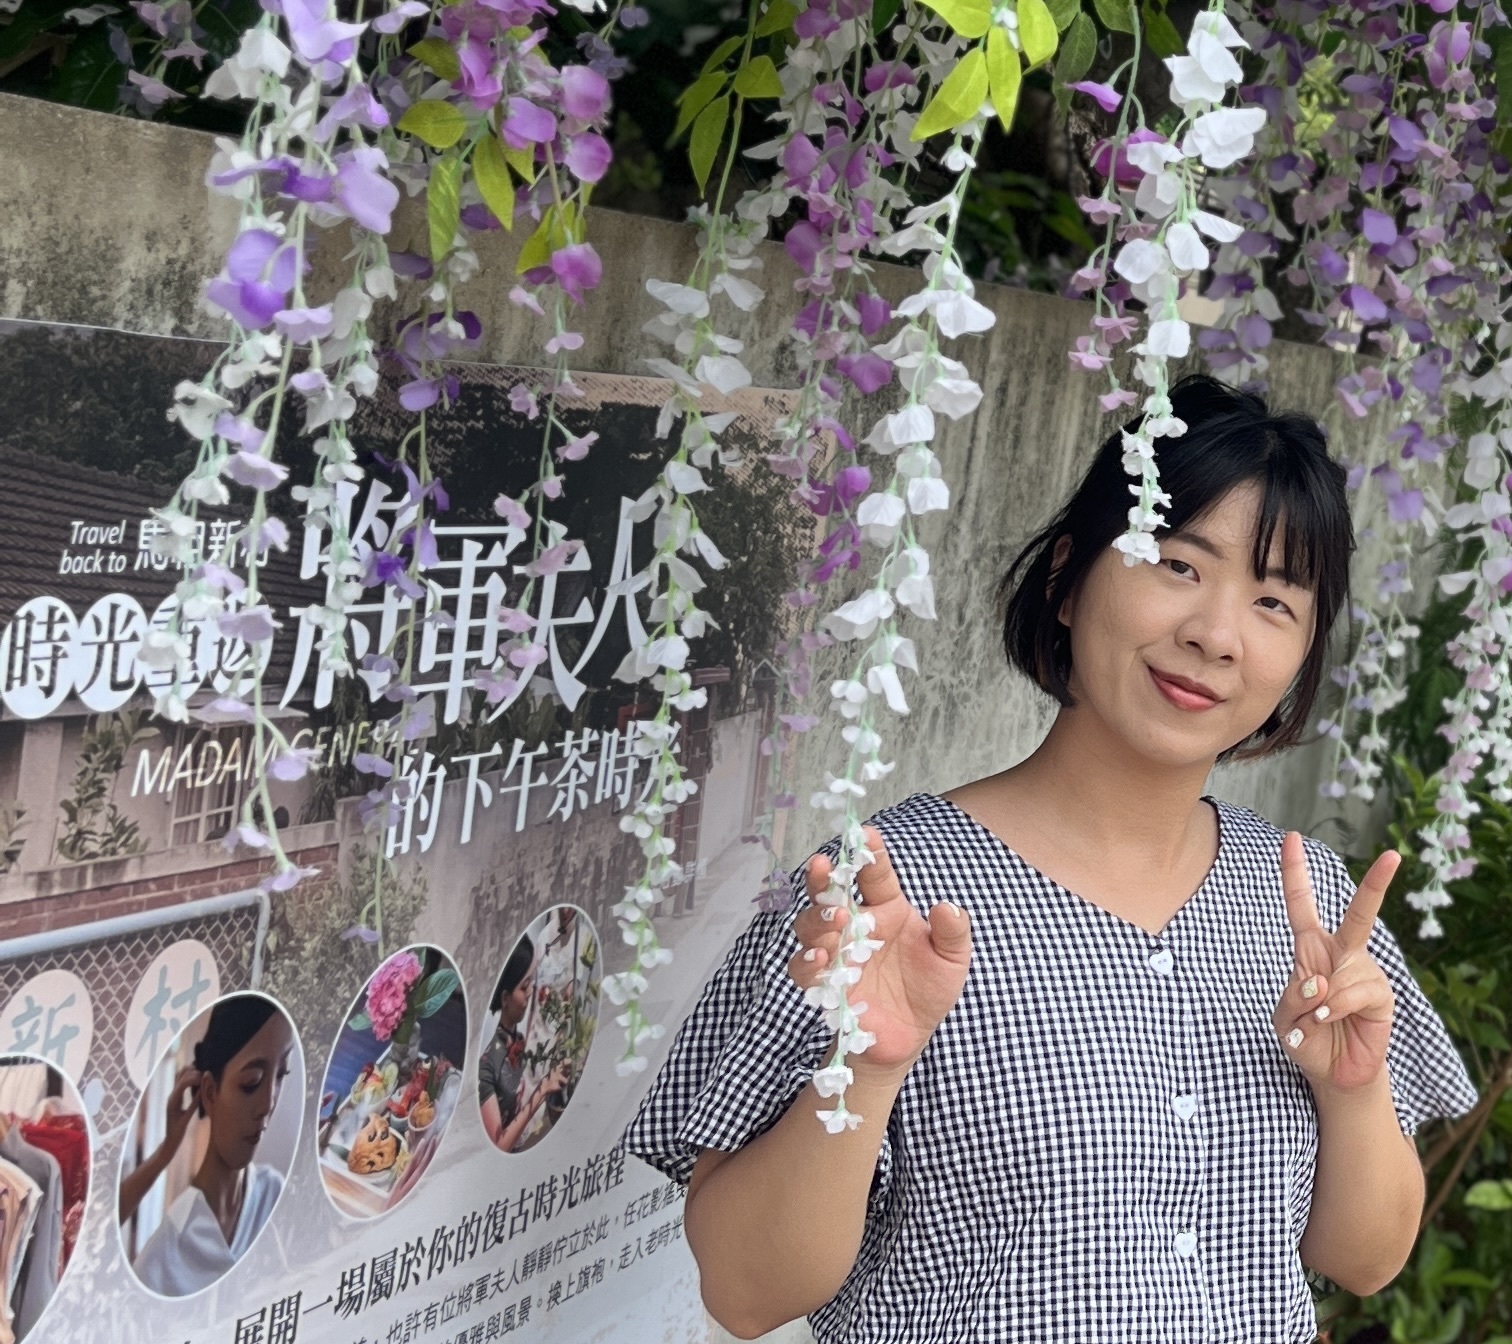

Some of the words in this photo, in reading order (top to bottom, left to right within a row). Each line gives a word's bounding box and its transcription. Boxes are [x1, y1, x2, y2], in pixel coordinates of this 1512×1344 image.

[59, 549, 103, 574] back
[107, 549, 126, 573] to
[70, 519, 126, 545] Travel
[280, 478, 652, 725] 將軍夫人
[131, 730, 278, 798] MADAM
[386, 720, 682, 859] 的下午茶時光
